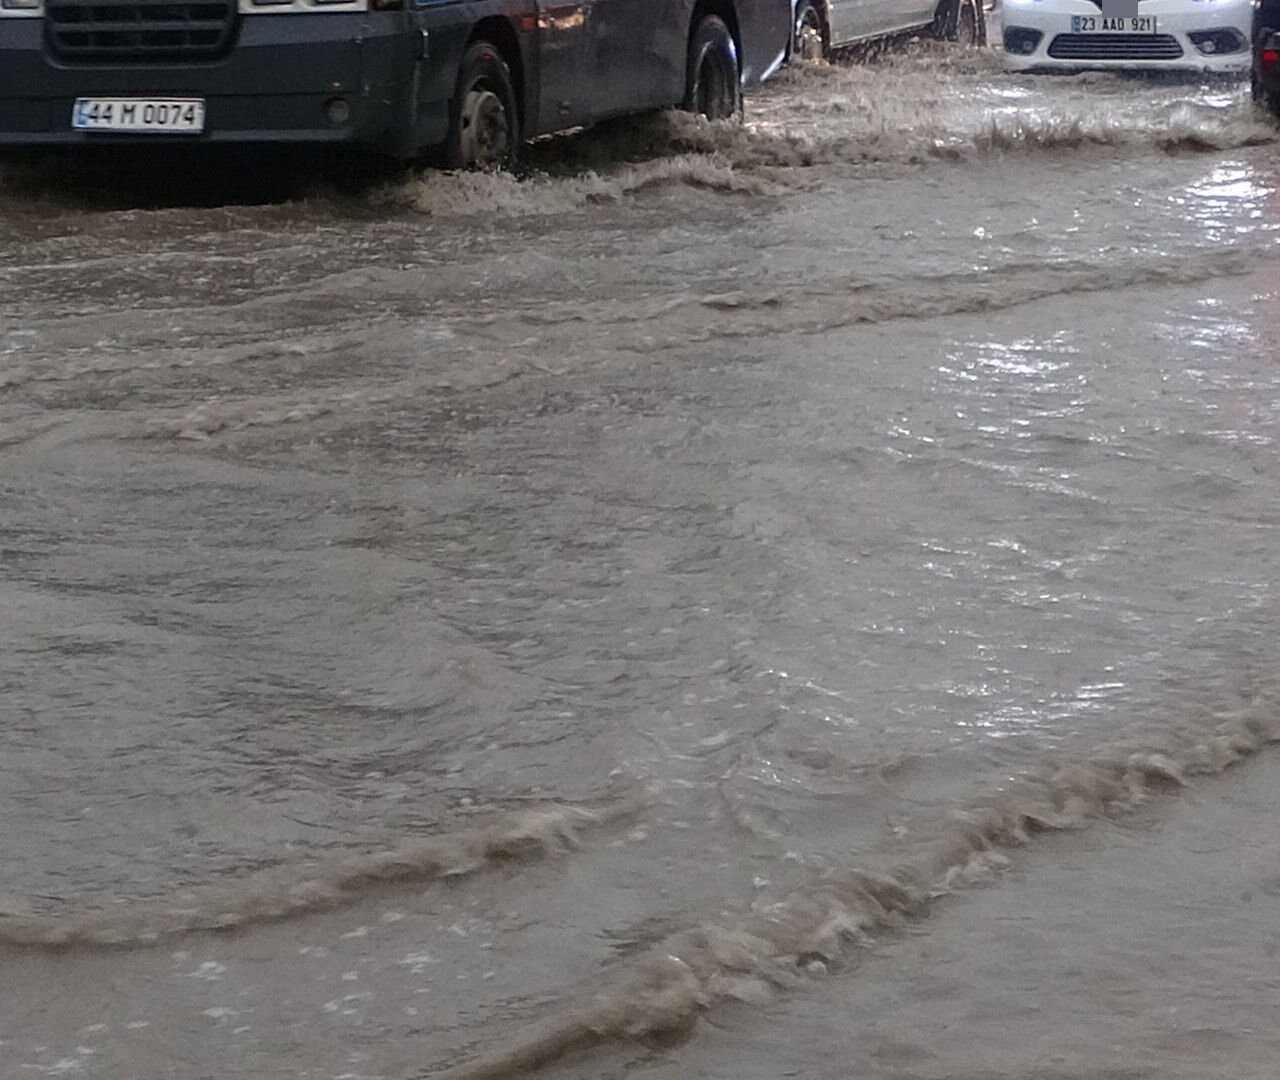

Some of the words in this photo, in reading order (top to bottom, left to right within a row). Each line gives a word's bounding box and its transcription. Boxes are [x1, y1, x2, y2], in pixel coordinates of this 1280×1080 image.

[1082, 17, 1096, 31] 23
[1131, 17, 1151, 32] 921
[89, 103, 112, 124] 44
[121, 104, 136, 124] M
[143, 104, 195, 125] 0074
